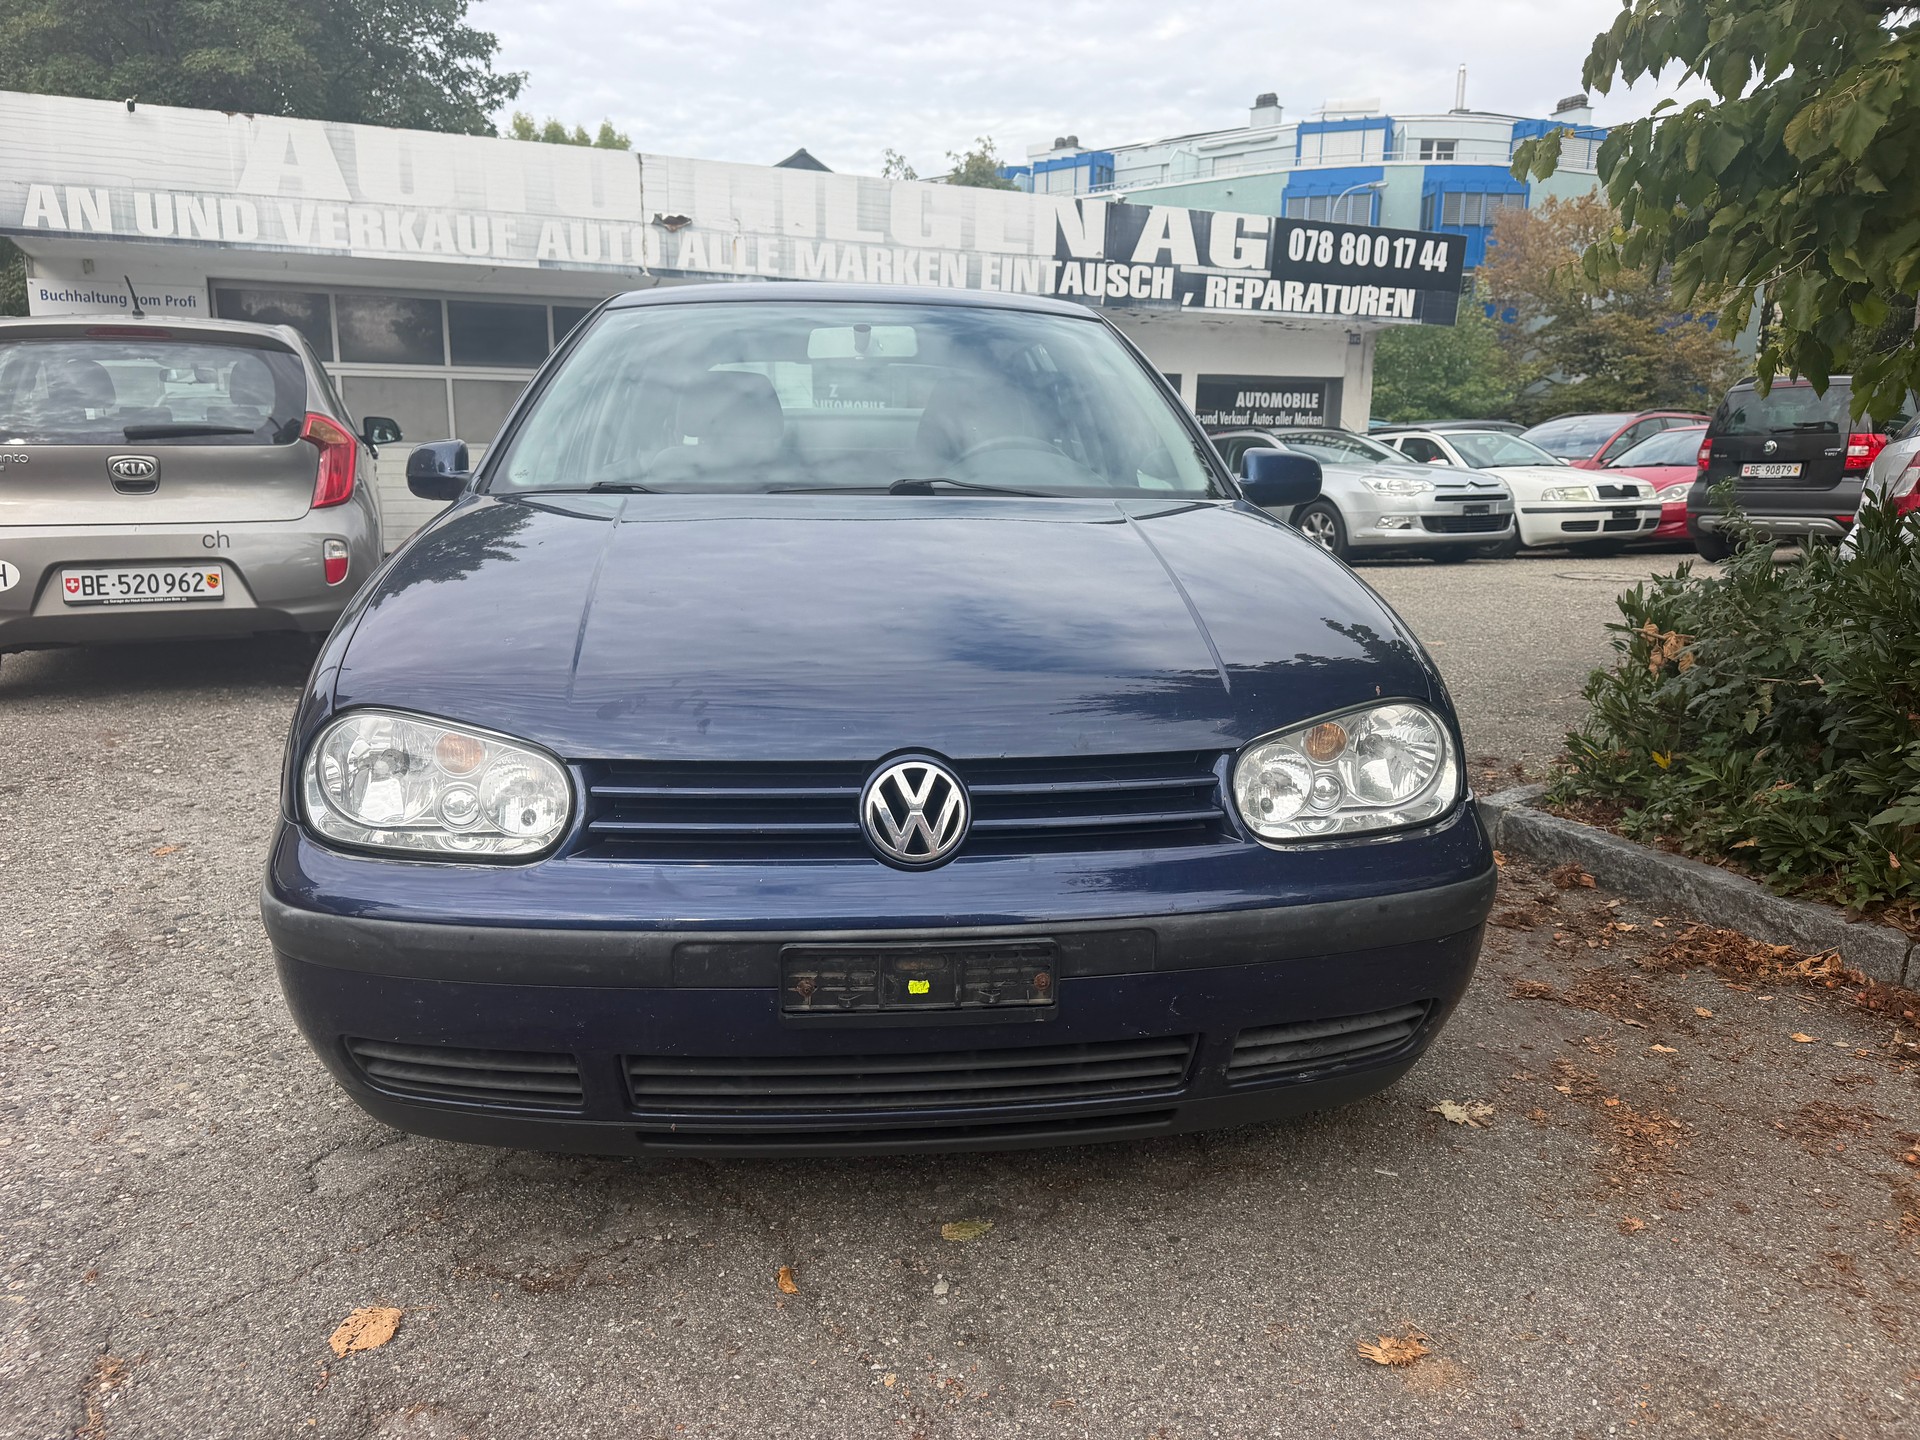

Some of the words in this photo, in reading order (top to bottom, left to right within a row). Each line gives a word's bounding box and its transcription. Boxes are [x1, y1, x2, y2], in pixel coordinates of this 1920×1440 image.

[1131, 204, 1269, 270] AG
[1288, 228, 1334, 264] 078
[22, 184, 113, 232] AN
[134, 191, 259, 241] UND
[278, 203, 518, 256] VERKAUF
[537, 220, 660, 265] AUTO
[676, 231, 779, 274] ALLE
[795, 239, 966, 287] MARKEN
[981, 256, 1174, 300] EINTAUSCH
[1204, 275, 1416, 317] REPARATUREN
[40, 289, 128, 308] Buchhaltung
[165, 295, 197, 308] Profi
[1235, 392, 1319, 408] AUTOMOBILE
[1220, 411, 1251, 425] Verkauf
[1252, 412, 1274, 426] Autos
[1275, 411, 1293, 426] aller
[1294, 412, 1323, 426] Marken
[119, 462, 149, 474] KIA
[202, 530, 230, 549] ch
